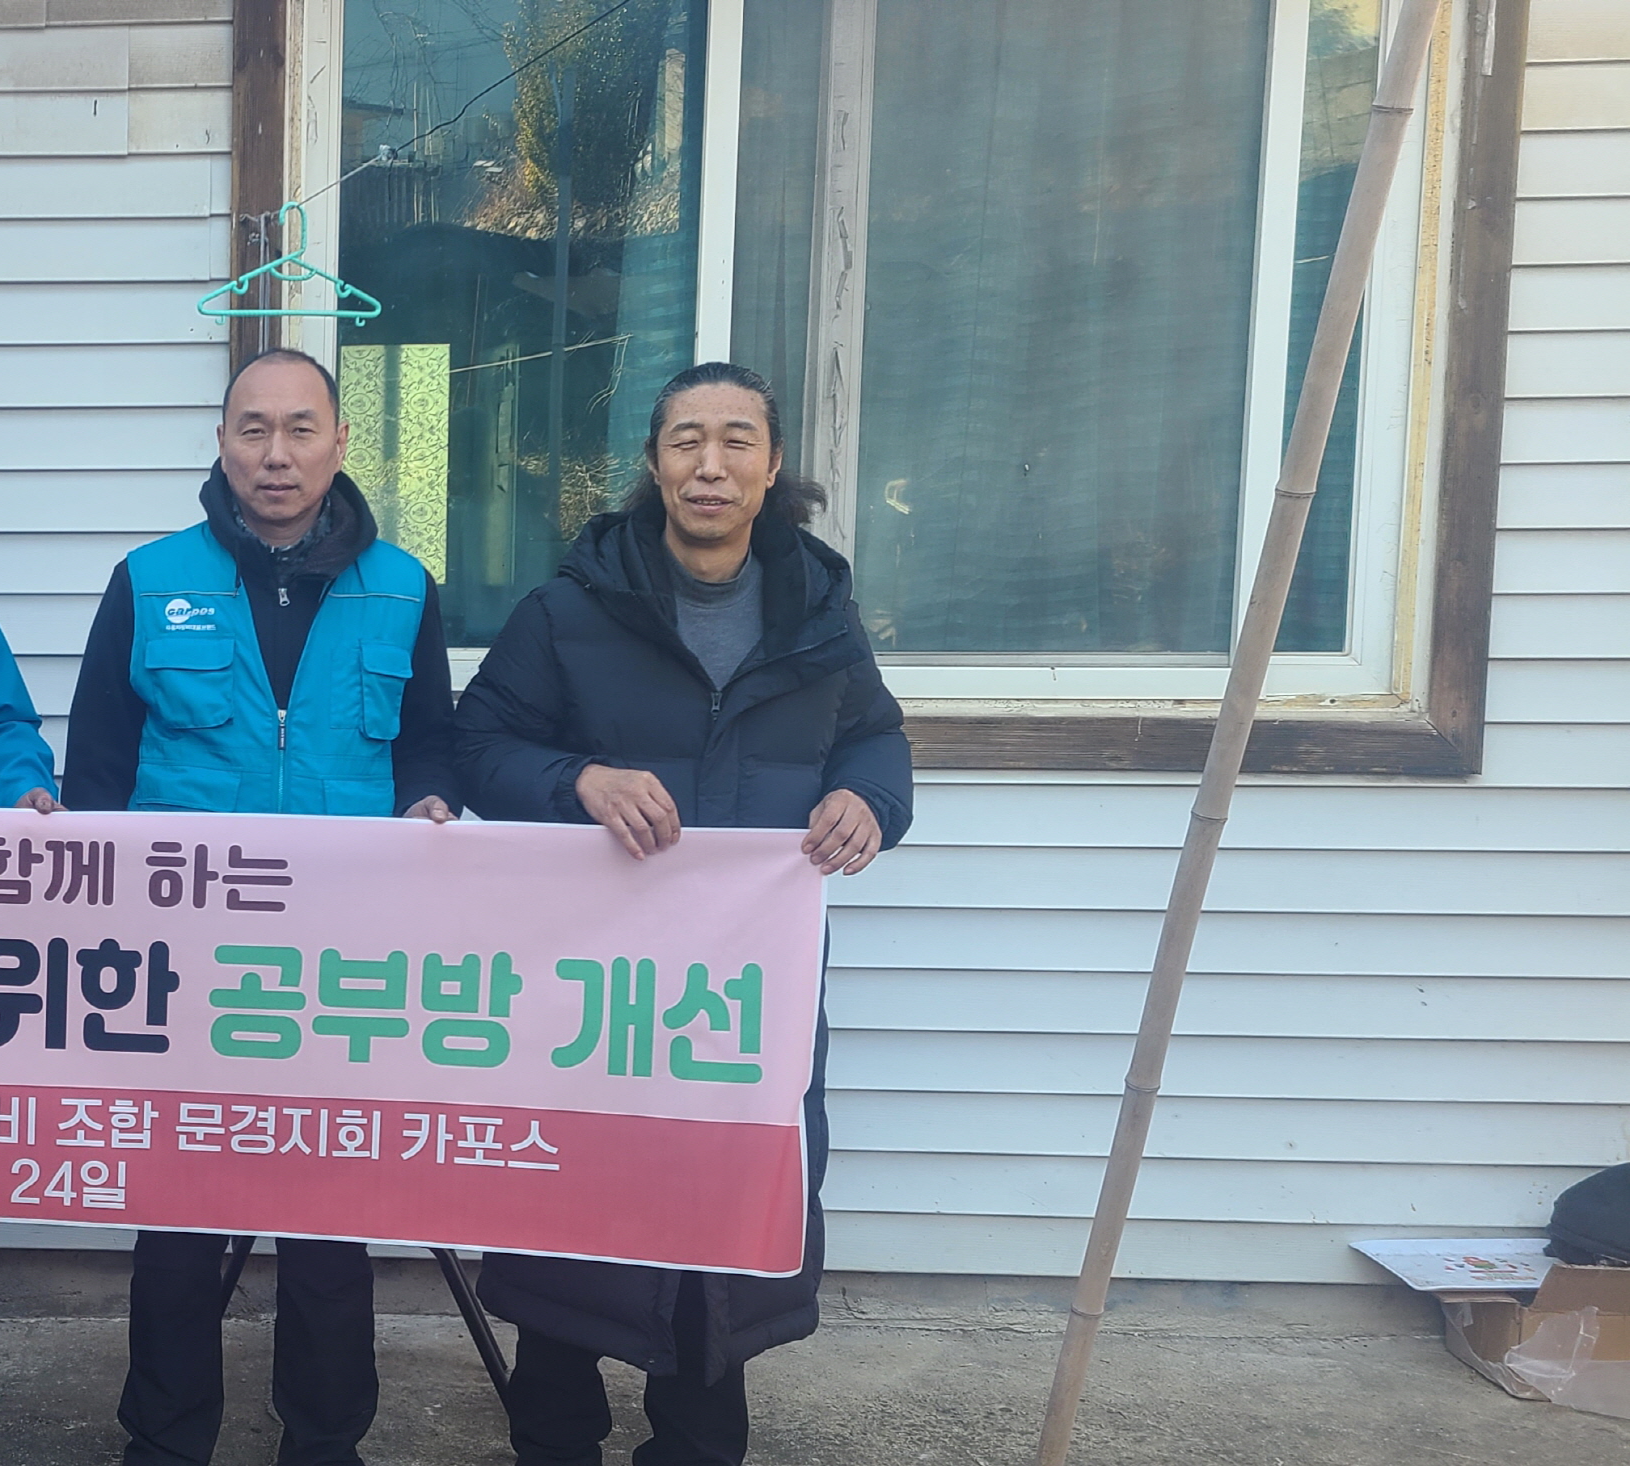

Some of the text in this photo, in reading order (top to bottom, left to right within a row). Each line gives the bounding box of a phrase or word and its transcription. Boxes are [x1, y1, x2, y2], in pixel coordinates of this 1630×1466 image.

[146, 841, 294, 913] 하는
[208, 944, 523, 1070] 공부방
[550, 956, 764, 1085] 개선
[55, 1097, 159, 1150] 조합
[175, 1102, 381, 1160] 문경지회
[400, 1112, 561, 1171] 카포스
[10, 1157, 127, 1210] 24일
